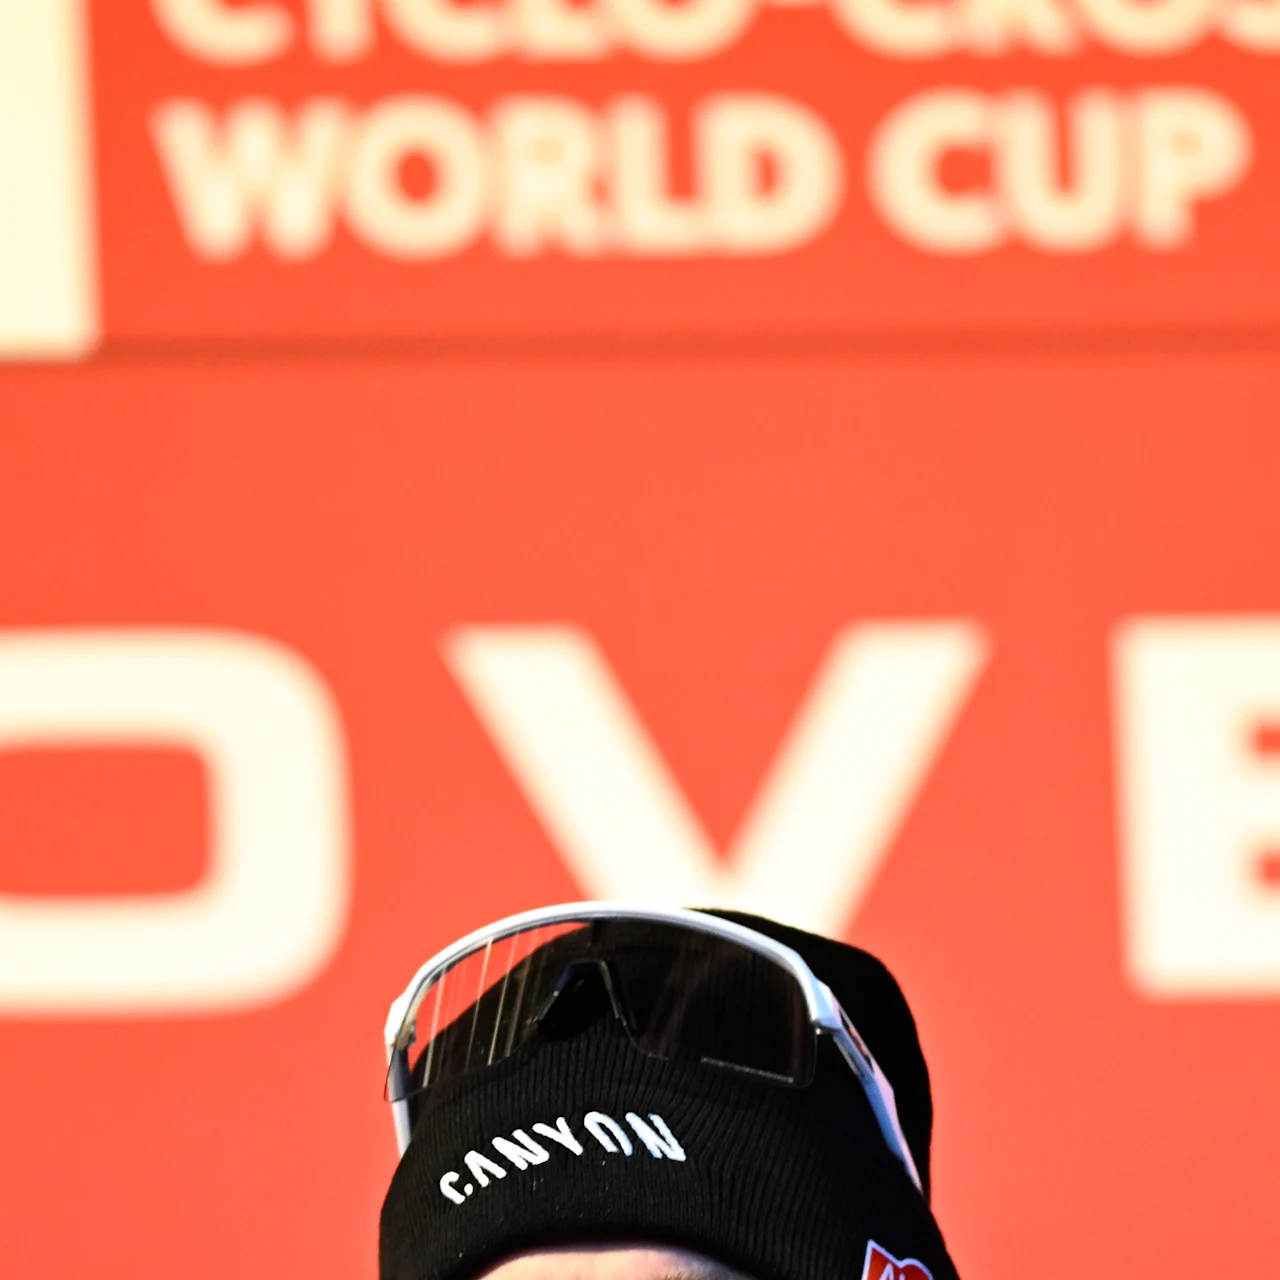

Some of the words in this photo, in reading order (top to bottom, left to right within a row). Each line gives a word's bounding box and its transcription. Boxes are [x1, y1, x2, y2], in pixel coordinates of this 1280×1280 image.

[151, 93, 844, 261] WORLD
[867, 87, 1253, 256] CUP
[439, 1110, 687, 1205] CANYON
